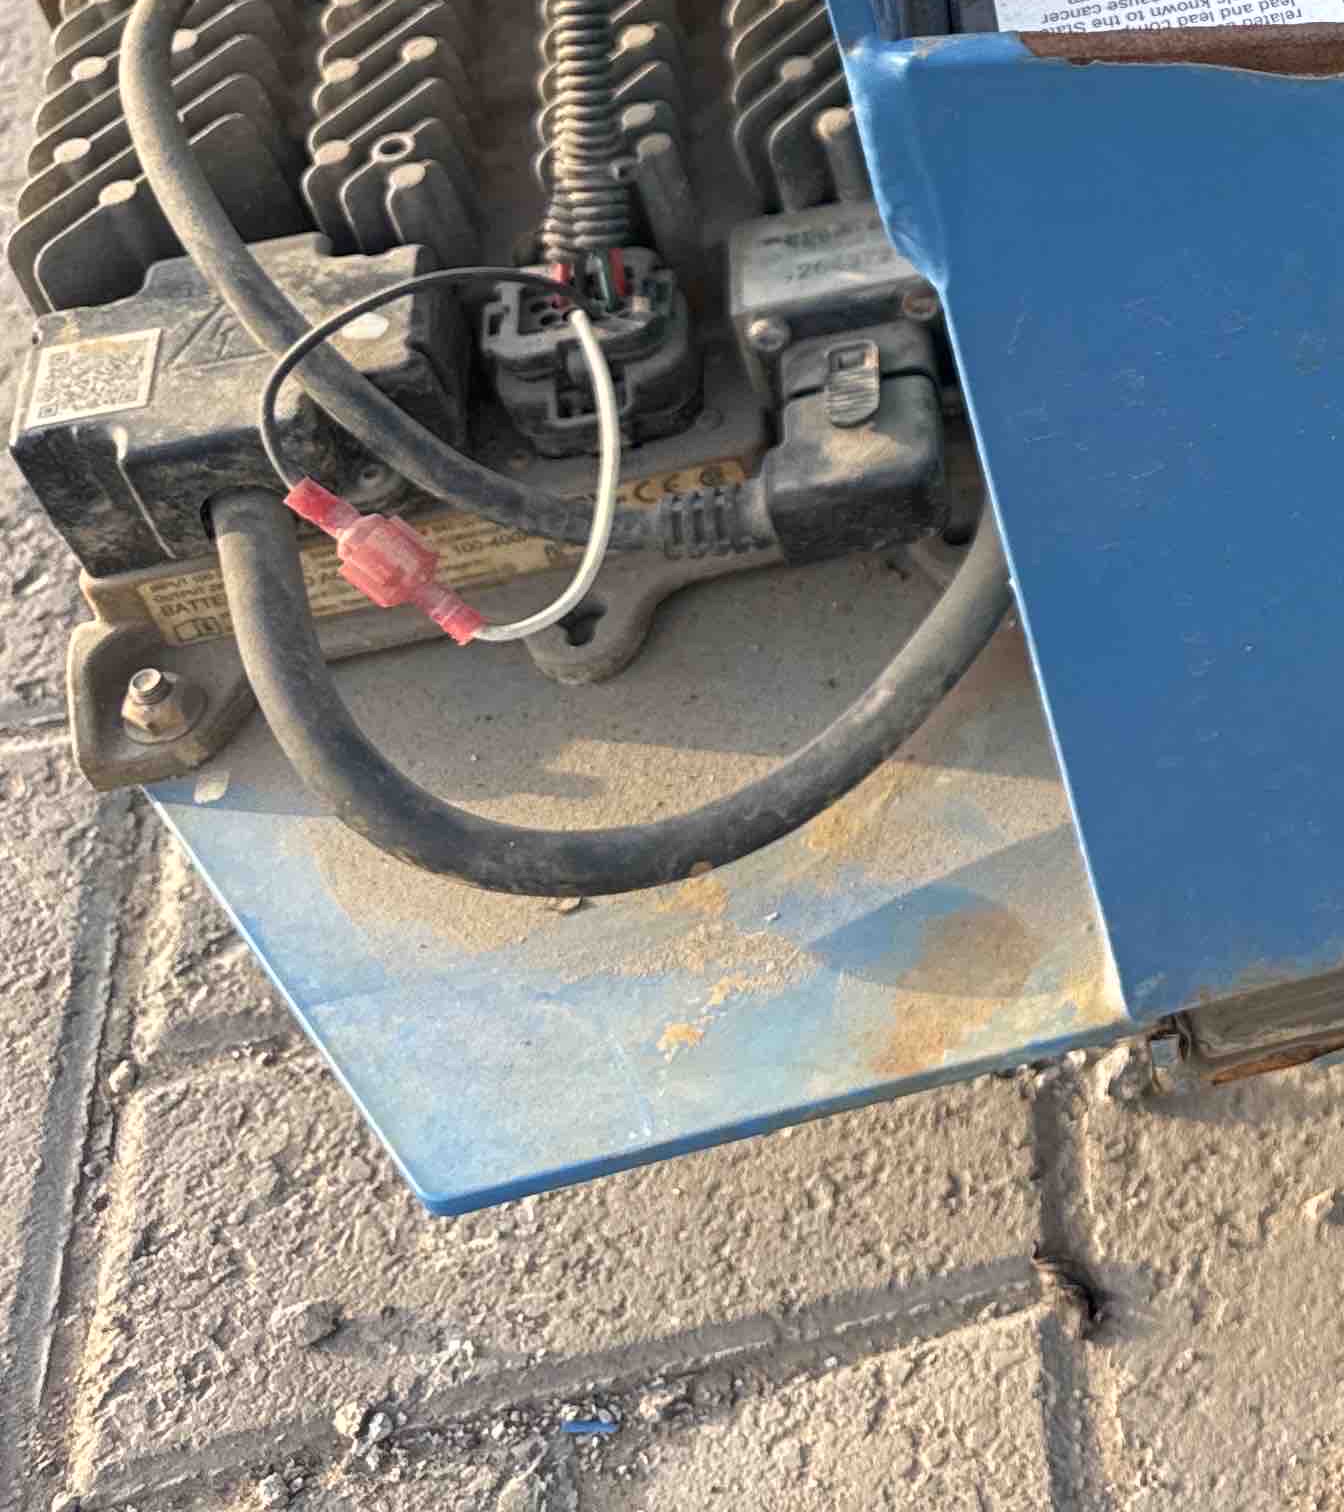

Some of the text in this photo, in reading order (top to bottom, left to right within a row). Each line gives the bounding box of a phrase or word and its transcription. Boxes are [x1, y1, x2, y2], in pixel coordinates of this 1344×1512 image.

[1038, 2, 1102, 25] cancer
[1125, 8, 1146, 23] to
[1176, 9, 1215, 28] lead
[1219, 1, 1254, 19] and
[1240, 7, 1303, 30] related
[1090, 13, 1121, 30] the
